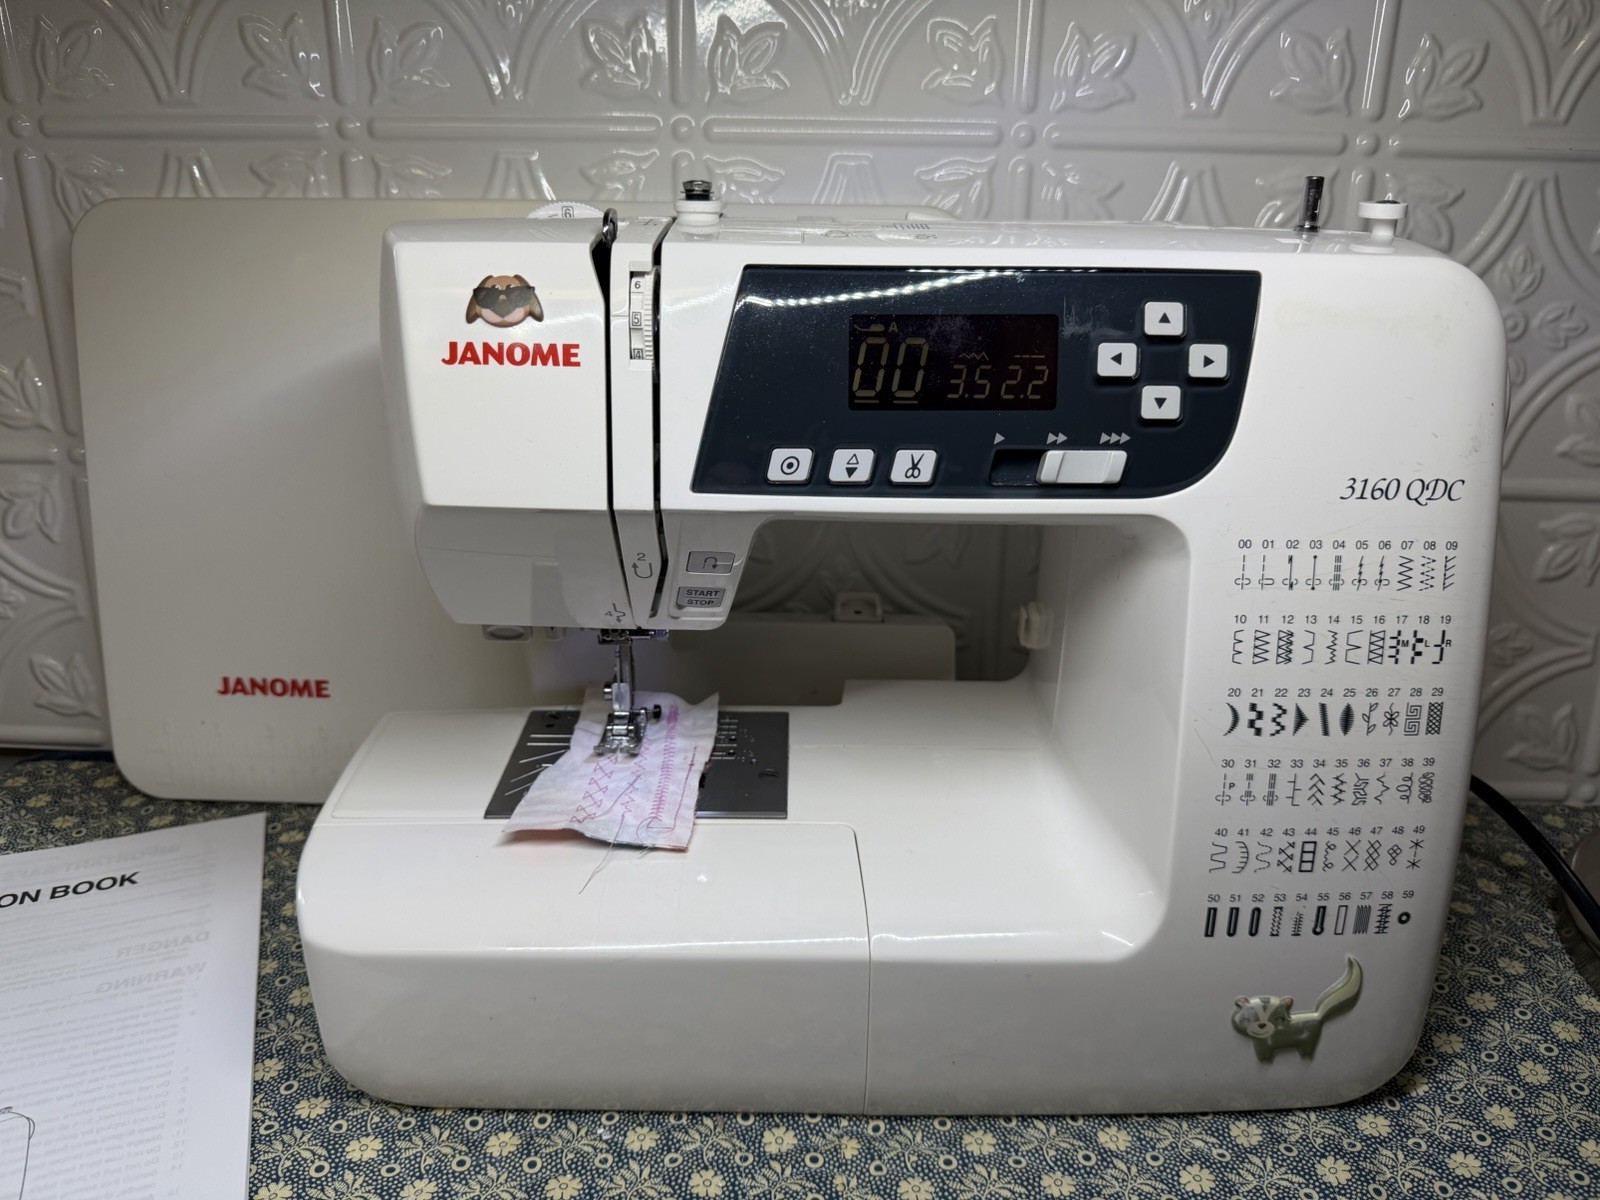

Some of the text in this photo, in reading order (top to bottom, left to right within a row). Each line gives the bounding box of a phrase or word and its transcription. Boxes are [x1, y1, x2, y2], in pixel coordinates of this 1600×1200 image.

[634, 280, 641, 289] 6
[633, 313, 640, 325] 5
[888, 321, 898, 333] A
[441, 341, 581, 367] JANOME
[635, 350, 642, 359] 4
[852, 336, 929, 398] 00
[947, 364, 1049, 400] 3.5 2.2
[1339, 477, 1466, 507] 3160 QDC
[1238, 539, 1458, 550] 00 01 02 03 04 05 06 07 08 09
[637, 552, 647, 562] 2
[686, 588, 720, 597] START
[687, 598, 715, 606] STOP
[1234, 614, 1452, 624] 10 11 12 13 14 15 16 17 18 19
[1401, 639, 1409, 647] M
[1424, 639, 1430, 647] L
[1445, 639, 1452, 647] R
[217, 676, 331, 698] JANOME
[1228, 687, 1443, 697] 20 21 22 23 24 25 26 27 28 29
[1221, 757, 1435, 768] 30 31 32 33 34 35 36 37 38 39
[1228, 782, 1235, 790] P
[1215, 825, 1425, 837] 40 41 42 43 44 45 46 47 48 49
[50, 871, 140, 899] BOOK
[1207, 889, 1414, 902] 50 51 52 53 54 55 56 57 58 59
